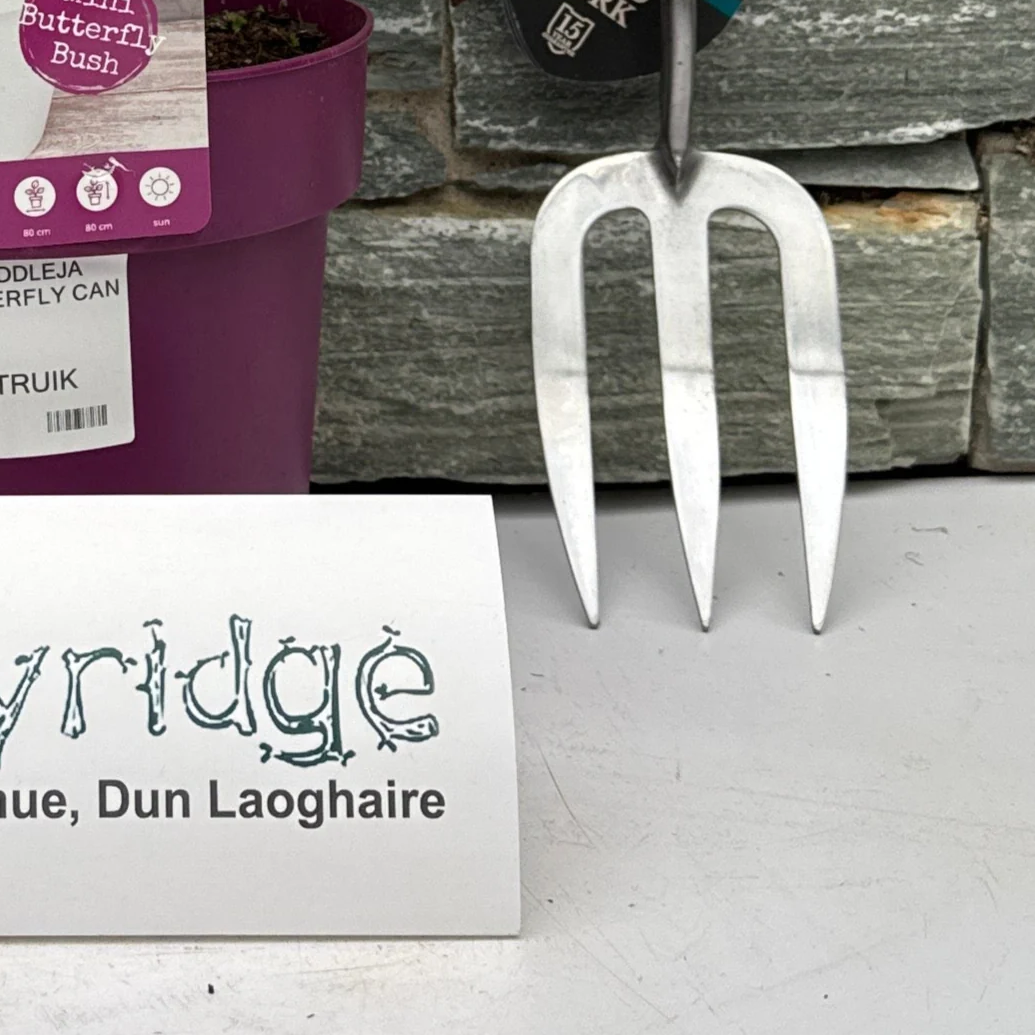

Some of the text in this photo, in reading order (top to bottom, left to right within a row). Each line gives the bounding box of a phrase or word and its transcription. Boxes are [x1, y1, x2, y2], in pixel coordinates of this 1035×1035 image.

[18, 2, 167, 56] Butterfly
[555, 13, 585, 40] 15
[50, 41, 119, 76] Bush
[22, 228, 52, 238] 80 cm
[84, 222, 113, 232] 80 cm
[153, 219, 171, 227] sun
[72, 279, 120, 301] CAN
[97, 780, 190, 820] Dun
[208, 778, 446, 830] Laoghaire
